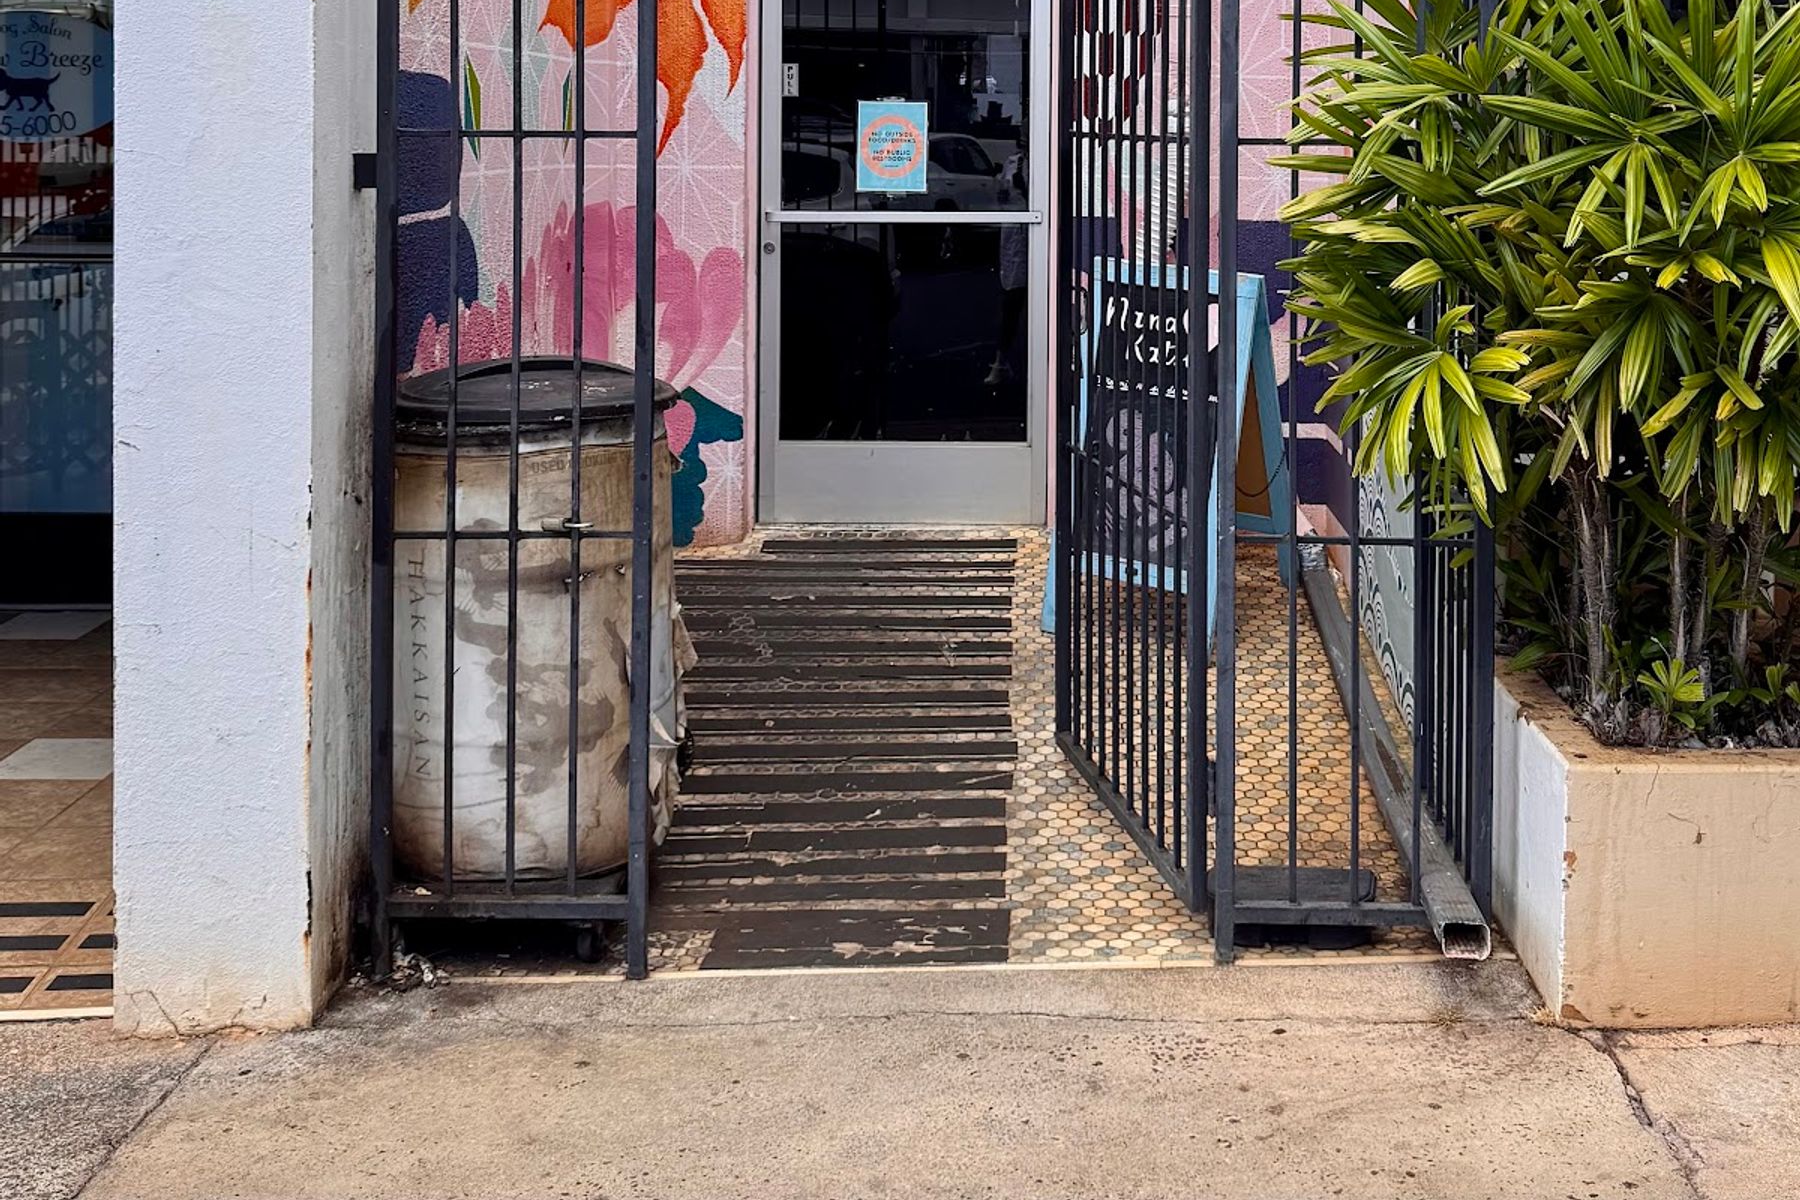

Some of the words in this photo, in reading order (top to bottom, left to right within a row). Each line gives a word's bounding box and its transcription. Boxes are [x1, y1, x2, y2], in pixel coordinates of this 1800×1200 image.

[0, 23, 18, 37] og
[23, 15, 73, 40] Salon
[20, 40, 105, 76] Breeze
[531, 457, 564, 474] USED
[407, 558, 431, 777] HAKKAISAN
